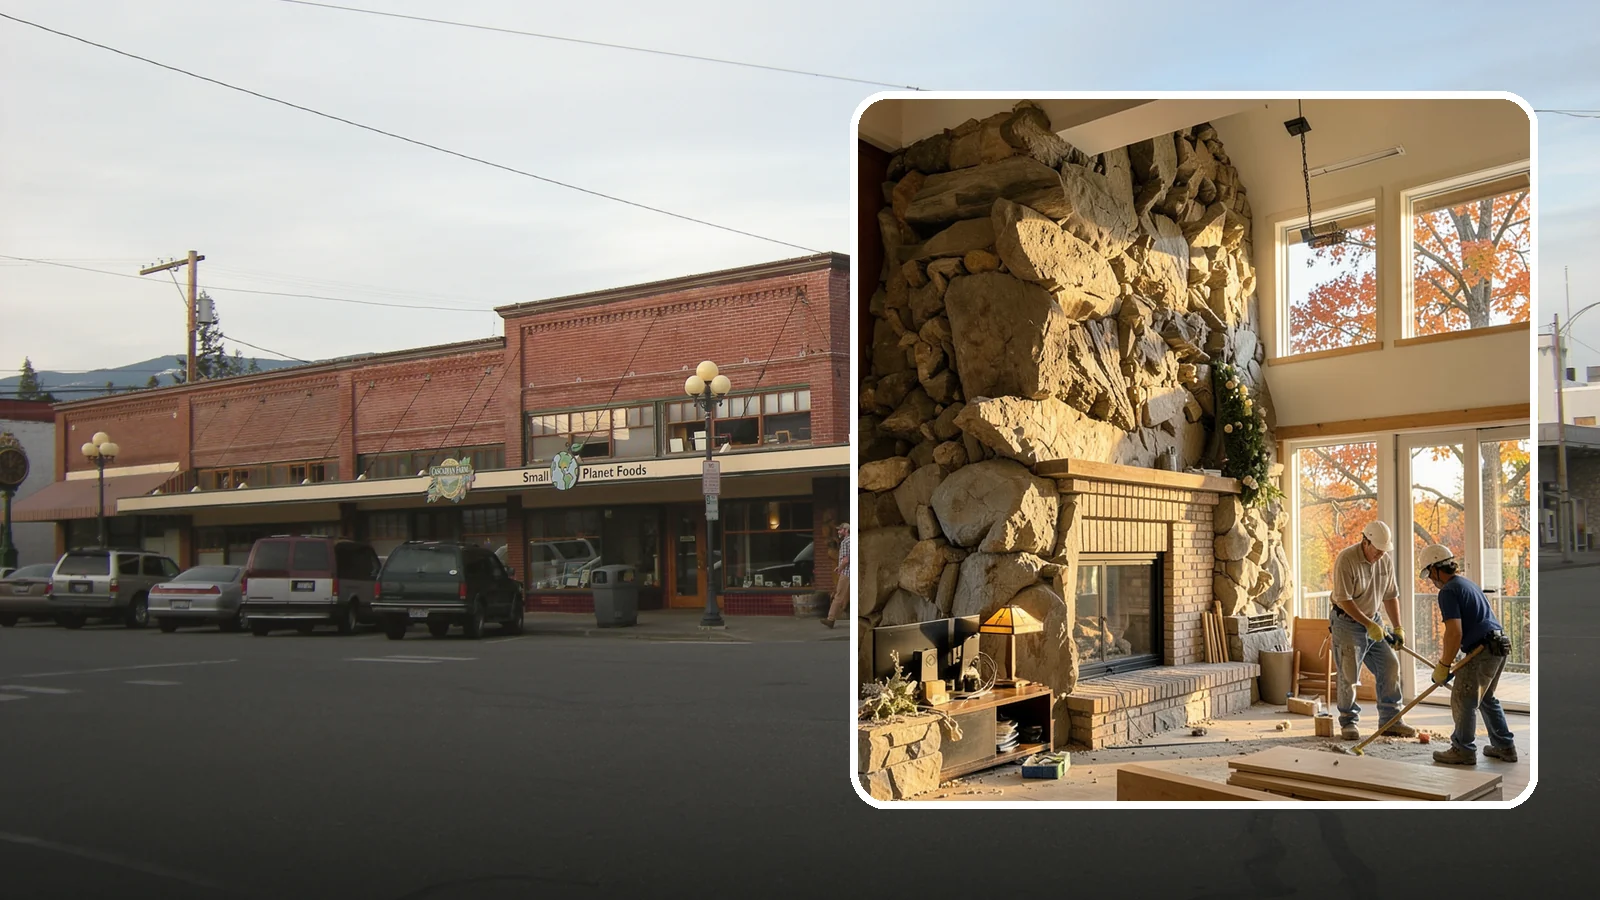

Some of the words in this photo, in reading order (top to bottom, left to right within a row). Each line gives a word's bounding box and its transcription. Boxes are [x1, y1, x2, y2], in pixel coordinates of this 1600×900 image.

[523, 471, 549, 483] Small
[583, 467, 614, 479] Planet
[617, 464, 647, 477] Foods
